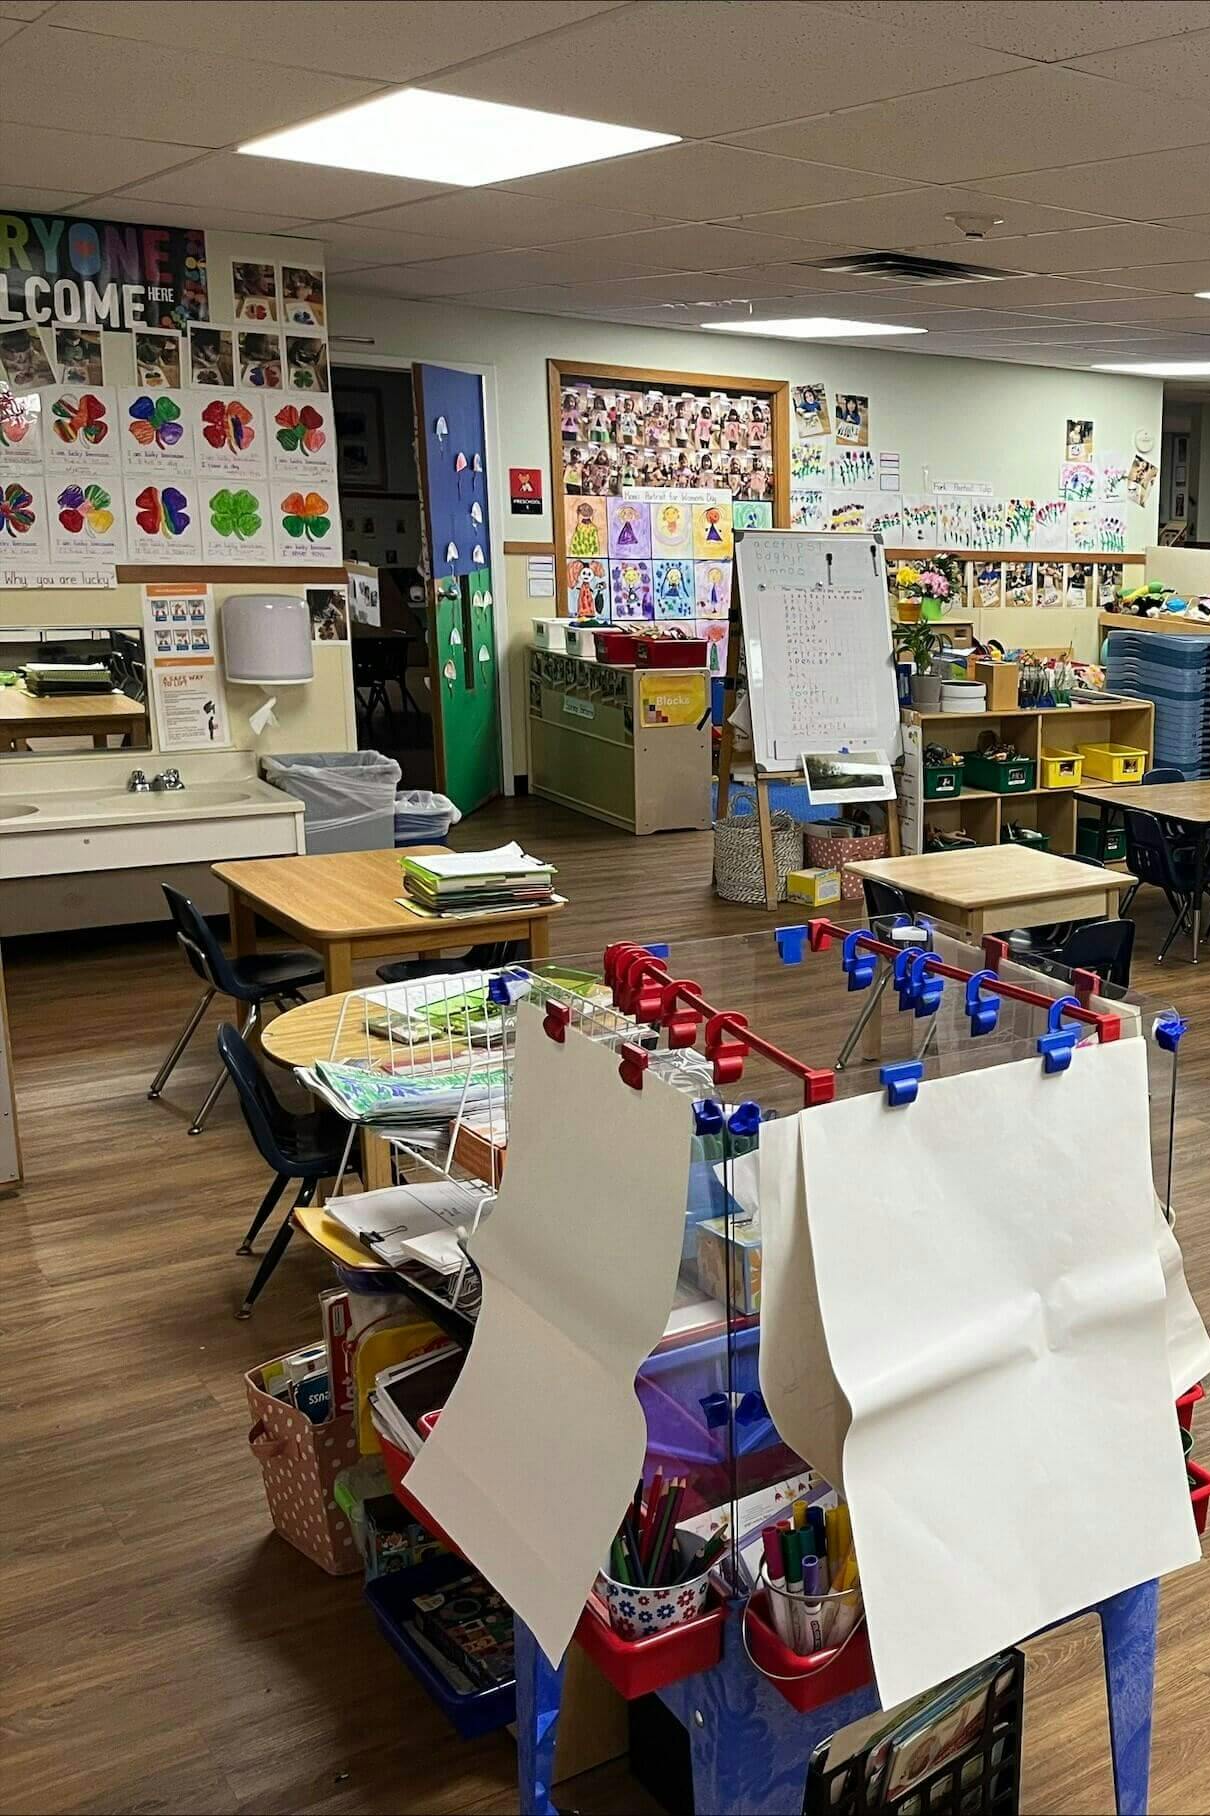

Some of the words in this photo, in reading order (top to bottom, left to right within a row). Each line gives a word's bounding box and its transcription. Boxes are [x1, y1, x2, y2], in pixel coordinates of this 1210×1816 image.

[148, 286, 174, 303] HERE
[4, 571, 27, 589] Why
[37, 575, 54, 589] you
[60, 575, 77, 585] are
[656, 697, 689, 705] Blocks
